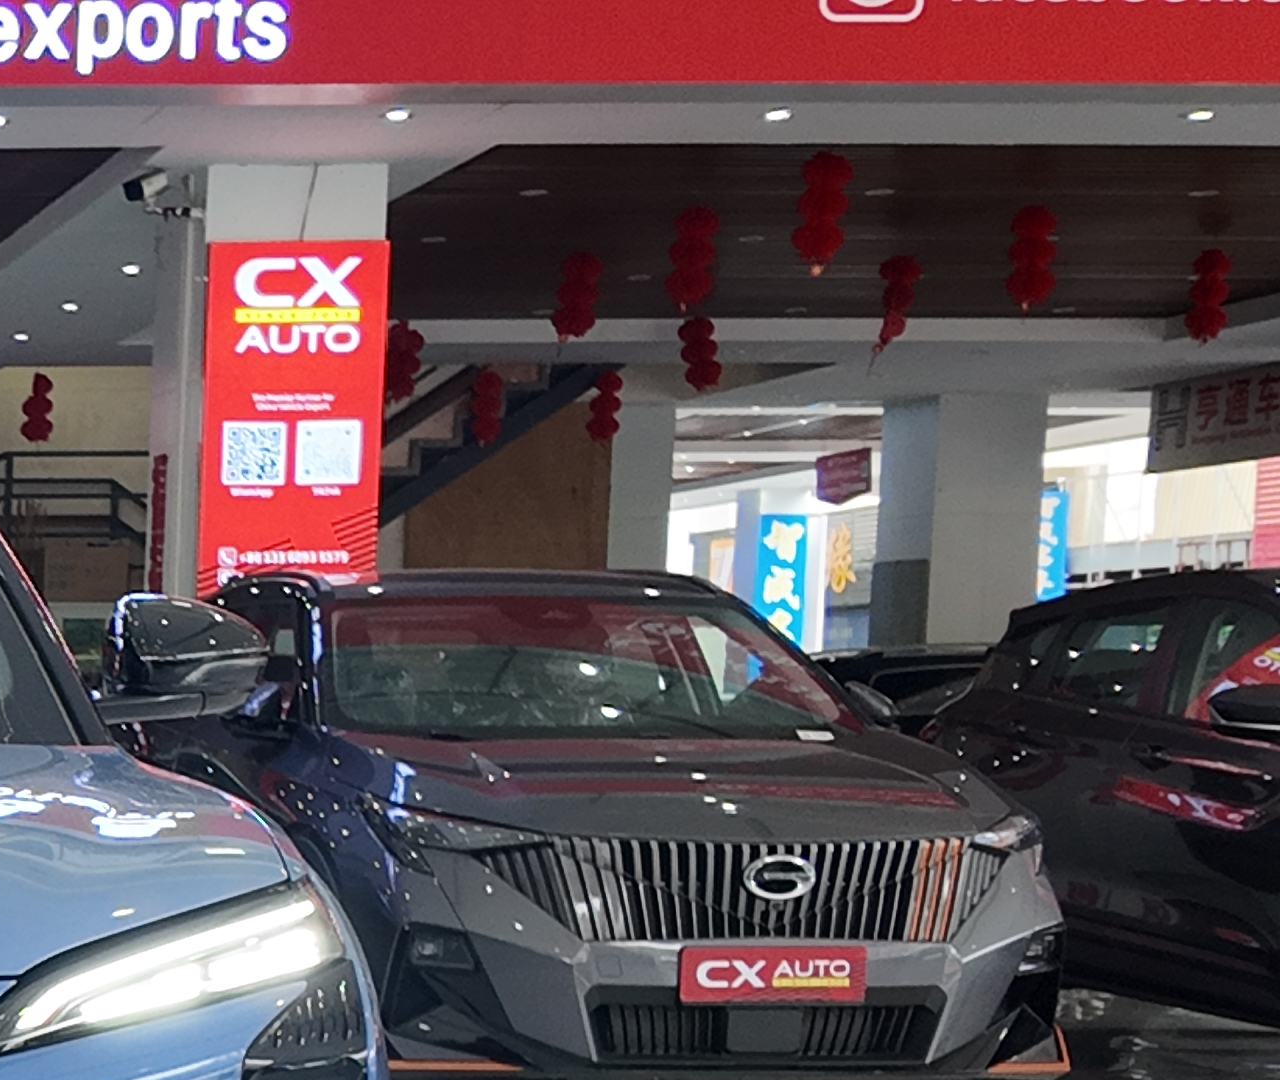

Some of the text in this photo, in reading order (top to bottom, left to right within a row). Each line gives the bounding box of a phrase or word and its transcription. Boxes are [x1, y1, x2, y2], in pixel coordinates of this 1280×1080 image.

[234, 256, 363, 308] CX
[234, 324, 361, 355] AUTO
[695, 959, 767, 988] CX
[773, 958, 851, 977] AUTO
